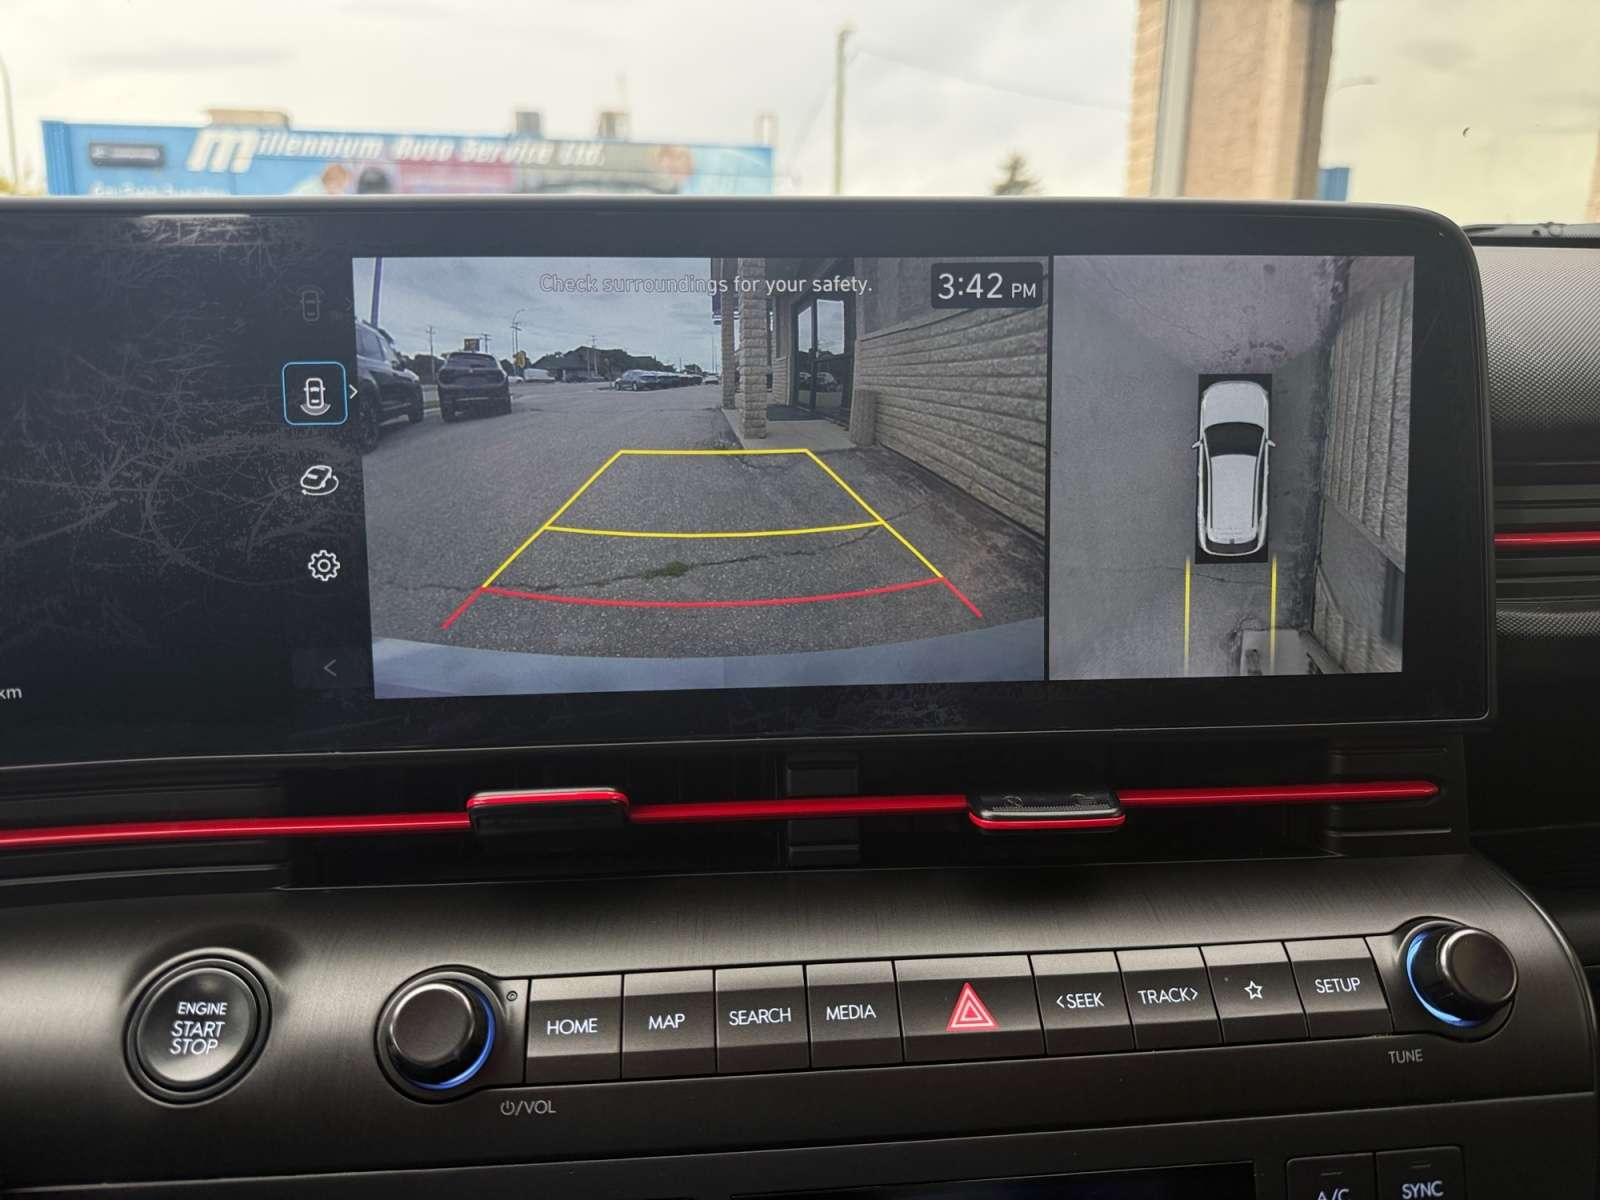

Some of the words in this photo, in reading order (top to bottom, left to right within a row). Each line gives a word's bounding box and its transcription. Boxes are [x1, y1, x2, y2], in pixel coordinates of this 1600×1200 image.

[539, 273, 598, 292] Check
[602, 273, 728, 296] surroundings
[734, 273, 759, 291] for
[765, 277, 807, 296] your
[811, 274, 873, 295] safety.
[937, 272, 1004, 300] 3:42
[1010, 283, 1037, 299] PM
[1314, 976, 1361, 996] SETUP
[177, 1001, 228, 1016] ENGINE
[728, 1007, 792, 1027] SEARCH
[825, 1003, 877, 1022] MEDIA
[171, 1020, 226, 1038] START
[546, 1017, 598, 1036] HOME
[648, 1013, 686, 1031] MAP
[169, 1038, 219, 1056] STOP
[1387, 1048, 1424, 1065] TUNE
[1401, 1180, 1444, 1200] SYNC
